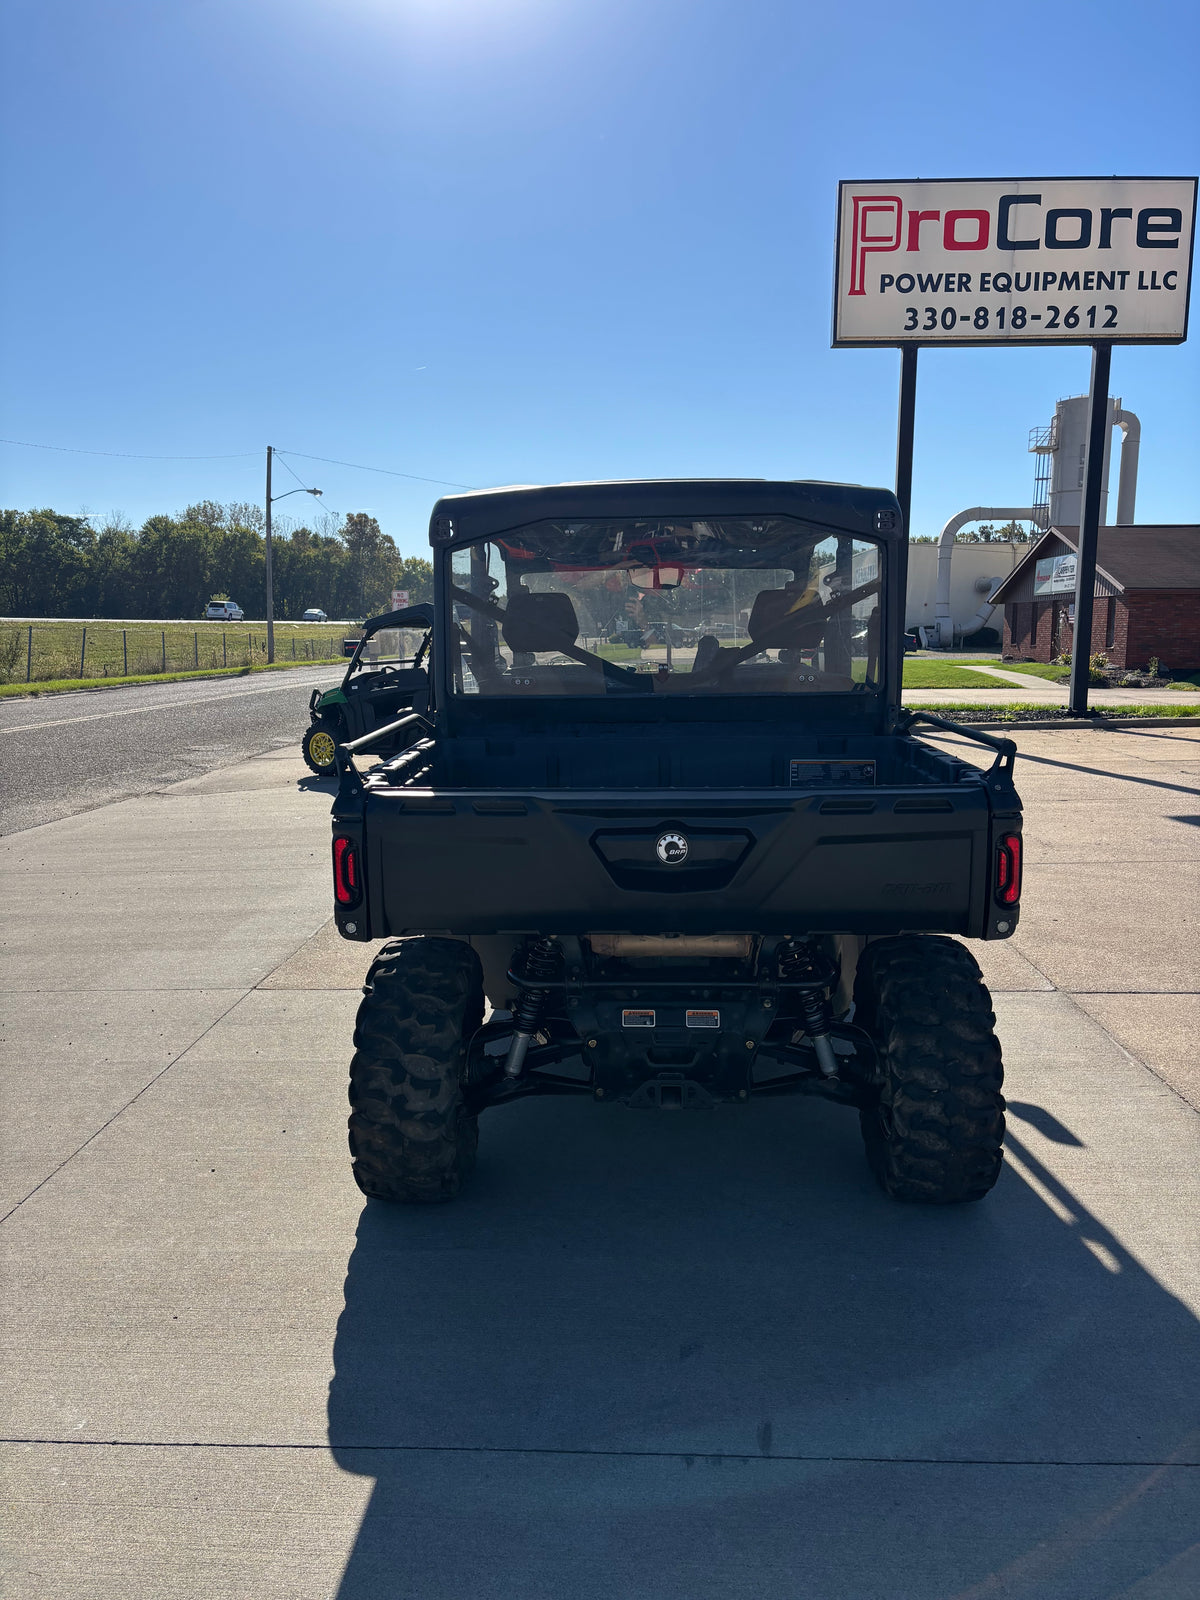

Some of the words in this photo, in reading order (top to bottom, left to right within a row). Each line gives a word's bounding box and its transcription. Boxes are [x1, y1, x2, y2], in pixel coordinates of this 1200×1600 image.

[848, 194, 1183, 296] ProCore
[880, 273, 972, 294] POWER
[980, 271, 1130, 294] EQUIPMENT
[1137, 270, 1178, 291] LLC
[903, 305, 1119, 331] 330-818-2612
